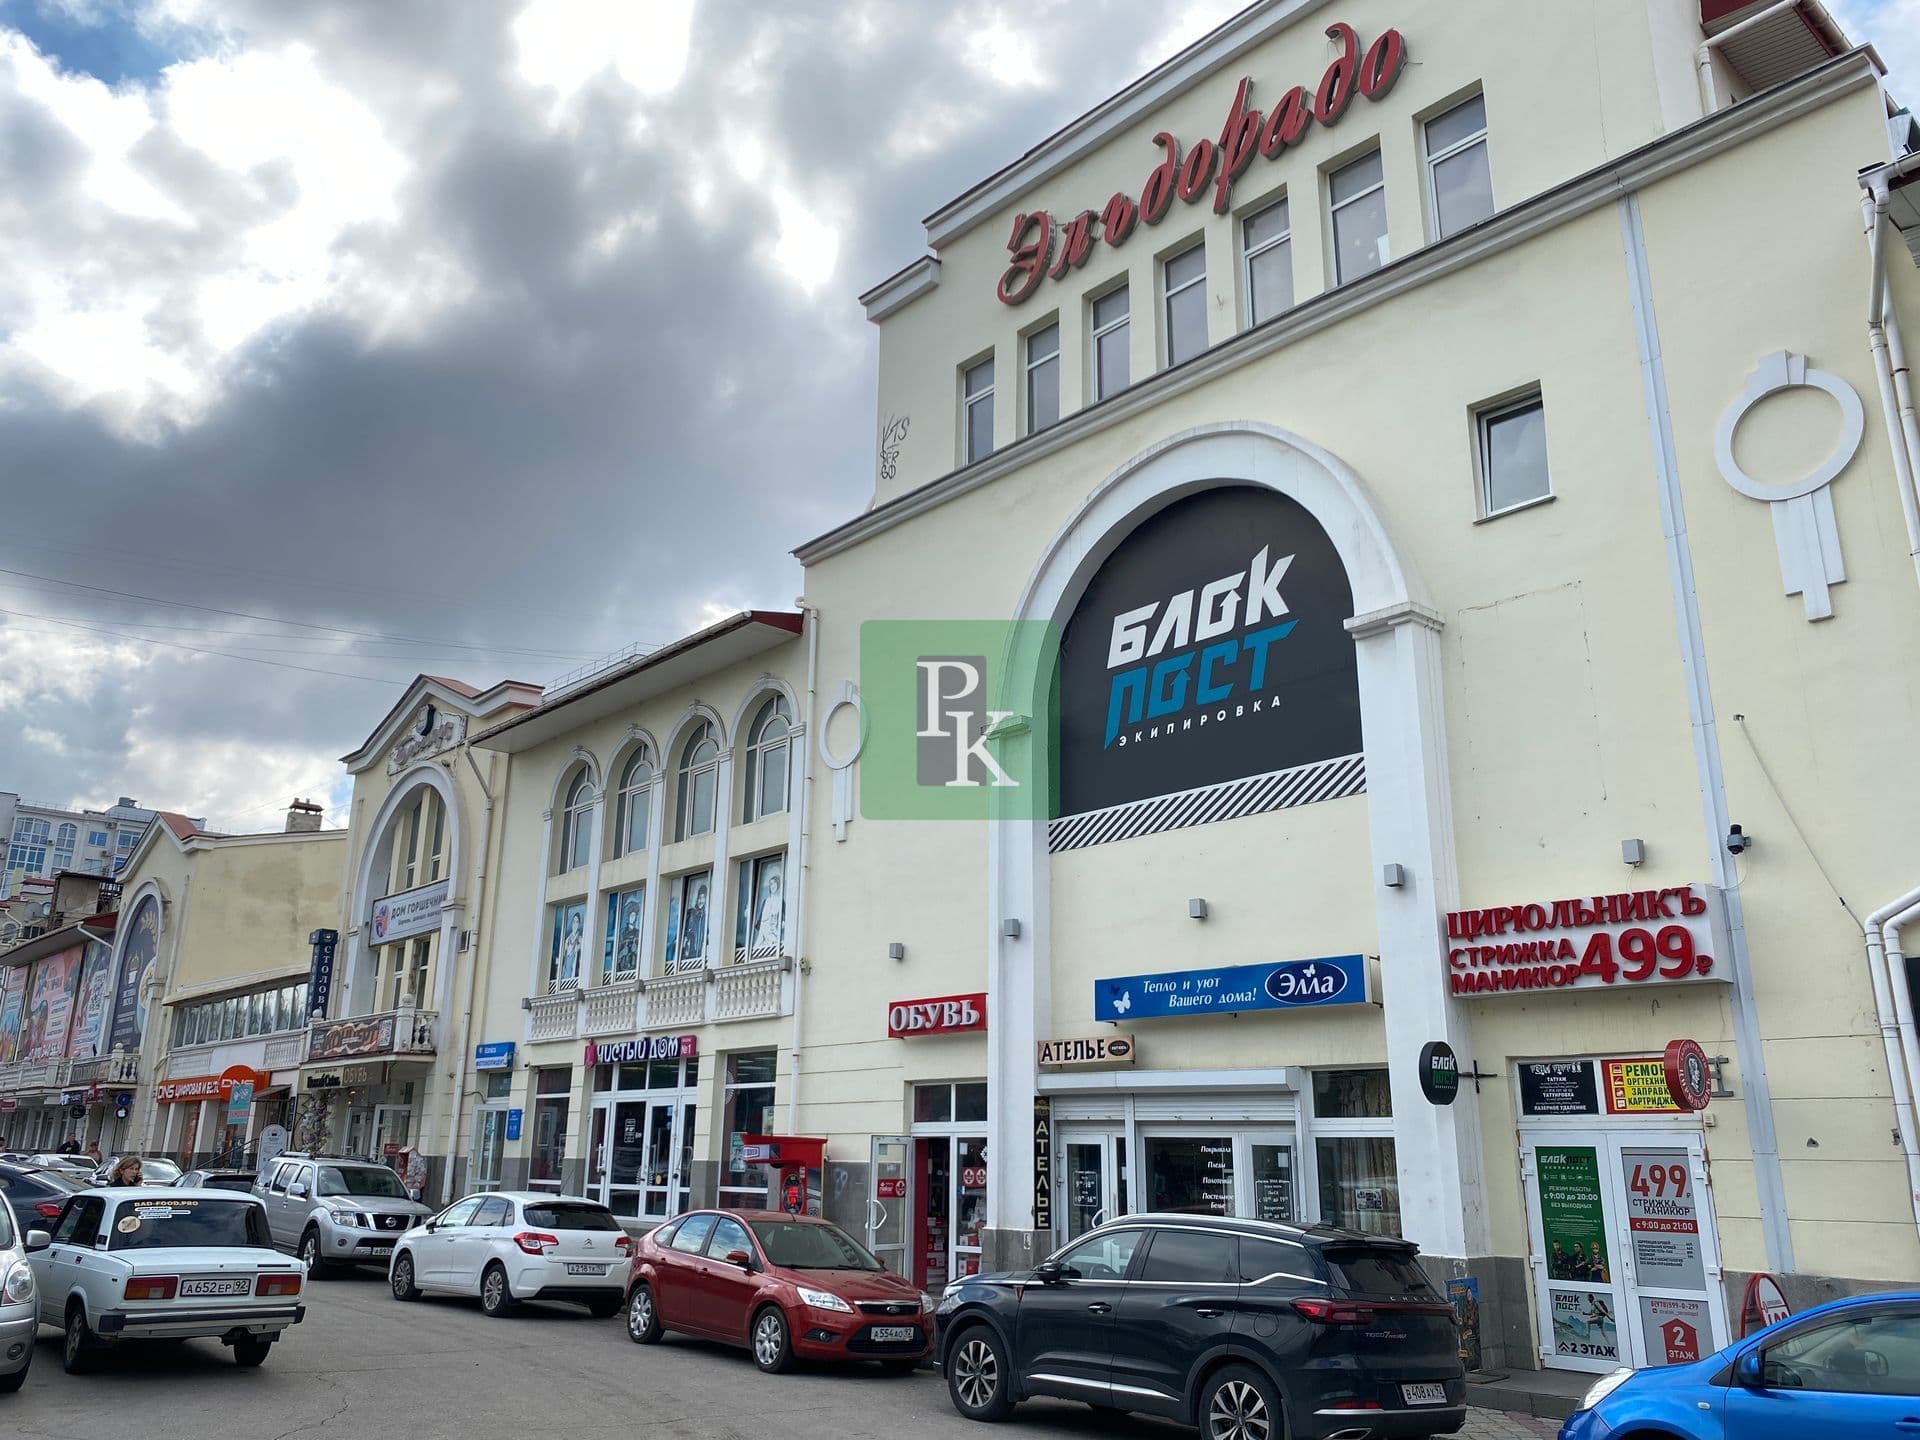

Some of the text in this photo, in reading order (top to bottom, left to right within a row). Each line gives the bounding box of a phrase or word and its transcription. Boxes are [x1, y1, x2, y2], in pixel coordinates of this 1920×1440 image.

[997, 21, 1408, 306] Эльдорадо
[1107, 544, 1295, 670] БЛОК
[1104, 620, 1299, 751] ПОСТ
[1118, 696, 1282, 747] ЭКИПИРОВКА
[1446, 886, 1707, 942] ЦИРЮЛЬНИКЪ
[1450, 938, 1576, 969] СТРИЖКА
[1143, 976, 1221, 994] Тепло и уют
[1277, 972, 1335, 998] Элла
[1451, 963, 1581, 993] МАНИКЮР
[1168, 987, 1257, 1008] Вашего дома!
[889, 998, 980, 1032] ОБУВЬ
[597, 1039, 647, 1063] ЧИСТЫЙ
[650, 1037, 679, 1059] ДОМ
[1041, 1038, 1106, 1061] АТЕЛЬЕ
[1432, 1053, 1455, 1071] БЛОК
[157, 1085, 175, 1099] DNS
[134, 1200, 199, 1208] BAD-FOOD.PRO
[1549, 1192, 1566, 1200] 9:00
[1577, 1193, 1598, 1201] 20:00
[1632, 1198, 1677, 1208] СТРИЖКА
[1644, 1206, 1690, 1216] МАНИКЮР
[1641, 1220, 1659, 1229] 9:00
[1660, 1223, 1672, 1231] до
[1673, 1222, 1693, 1231] 21:00
[1555, 1294, 1580, 1304] БЛОК
[1672, 1326, 1687, 1348] 2
[1570, 1342, 1617, 1358] 2 ЭТАЖ
[1668, 1350, 1695, 1360] ЭТАЖ
